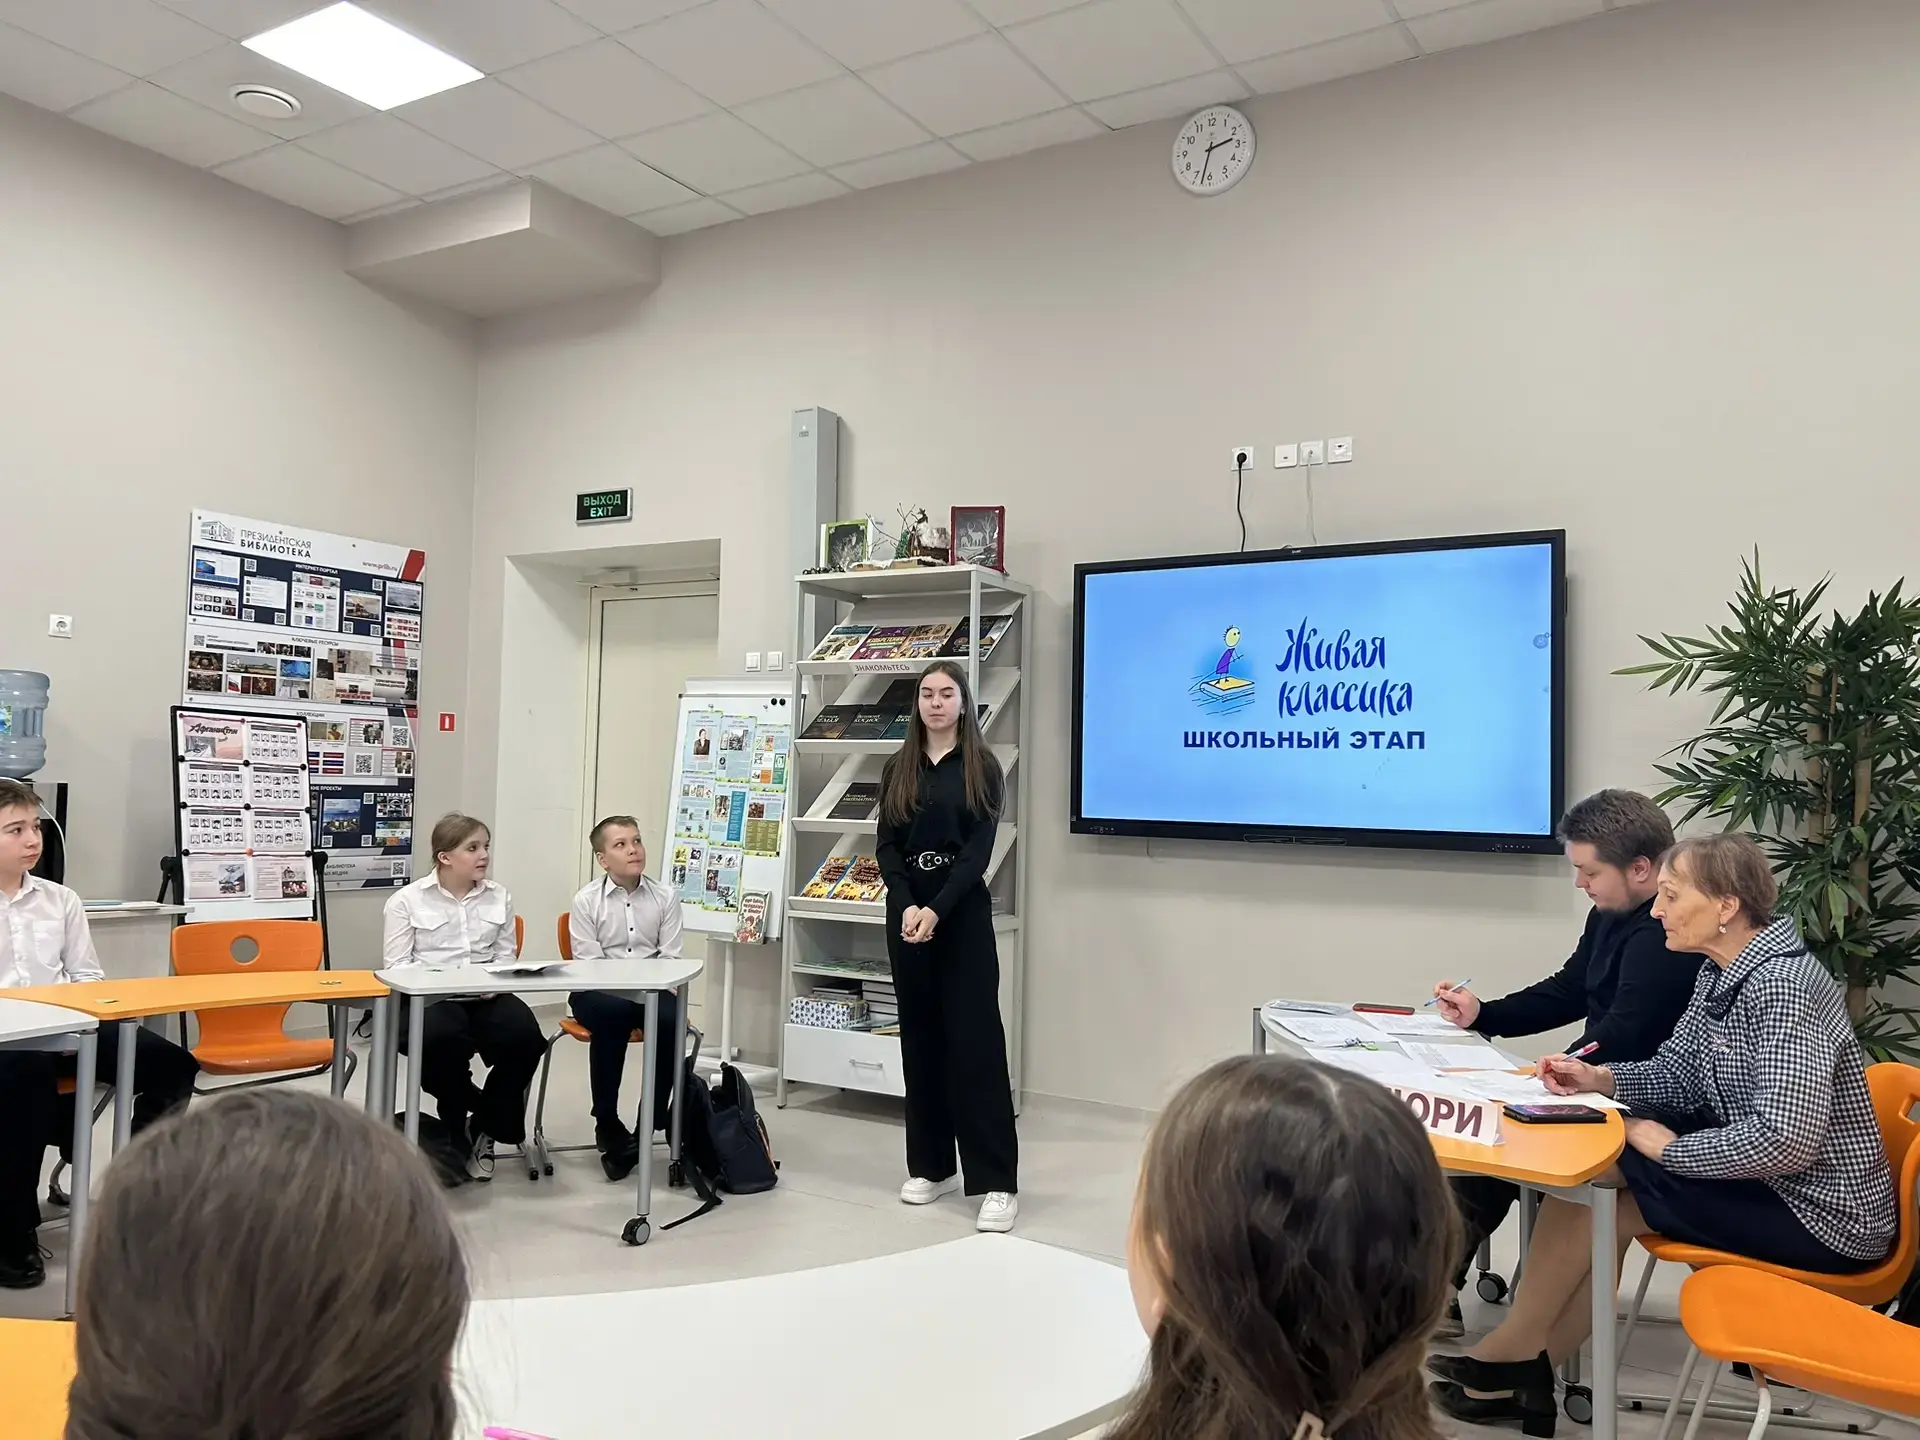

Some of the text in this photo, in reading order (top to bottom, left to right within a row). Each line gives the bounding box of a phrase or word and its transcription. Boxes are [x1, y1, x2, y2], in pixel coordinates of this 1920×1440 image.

[1208, 118, 1217, 127] 12
[1196, 124, 1203, 133] 11
[1231, 126, 1237, 136] 2
[1187, 135, 1196, 145] 10
[1235, 139, 1241, 148] 3
[1182, 150, 1188, 159] 9
[1230, 153, 1236, 162] 4
[1185, 162, 1191, 171] 8
[1222, 165, 1228, 174] 5
[1194, 170, 1200, 180] 7
[1207, 172, 1213, 181] 6
[583, 494, 621, 507] ВЫХОД
[590, 506, 613, 517] EXIT
[240, 529, 312, 550] ПРЕЗИДЕНТСКАЯ
[240, 539, 311, 559] БИБЛИОТЕКА
[1275, 615, 1386, 674] Живая
[855, 663, 910, 672] ЗНАКОМЬТЕСЬ
[1278, 678, 1413, 719] классика
[1183, 726, 1426, 750] ШКОЛЬНЫЙ ЭТАП
